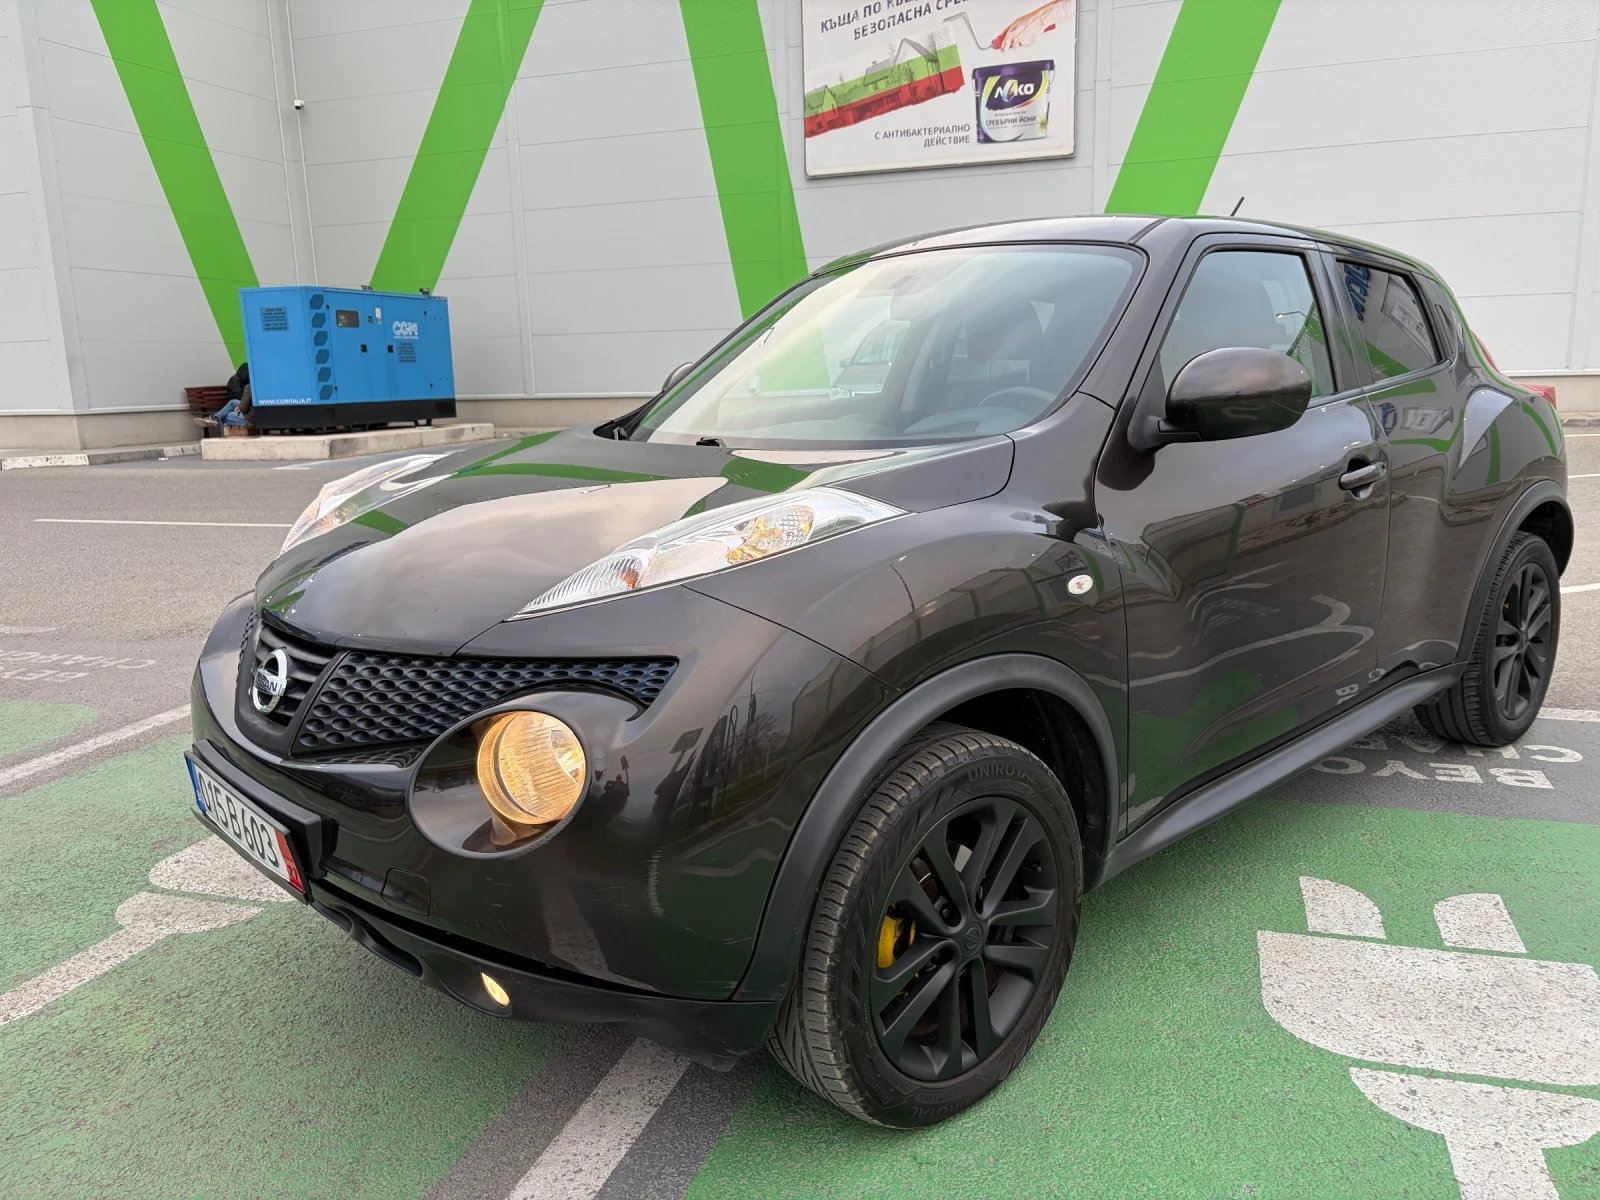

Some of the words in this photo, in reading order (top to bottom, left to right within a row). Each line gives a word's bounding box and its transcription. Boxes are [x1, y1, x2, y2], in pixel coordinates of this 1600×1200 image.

[820, 10, 860, 33] КЪЩА
[863, 1, 882, 18] ПО
[853, 3, 932, 40] БЕЗОПАСНА
[874, 132, 881, 140] С
[882, 123, 970, 140] АНТИБАКТЕРИАЛНО
[923, 134, 970, 148] ДЕЙСТВИЕ
[198, 771, 279, 868] 015B603
